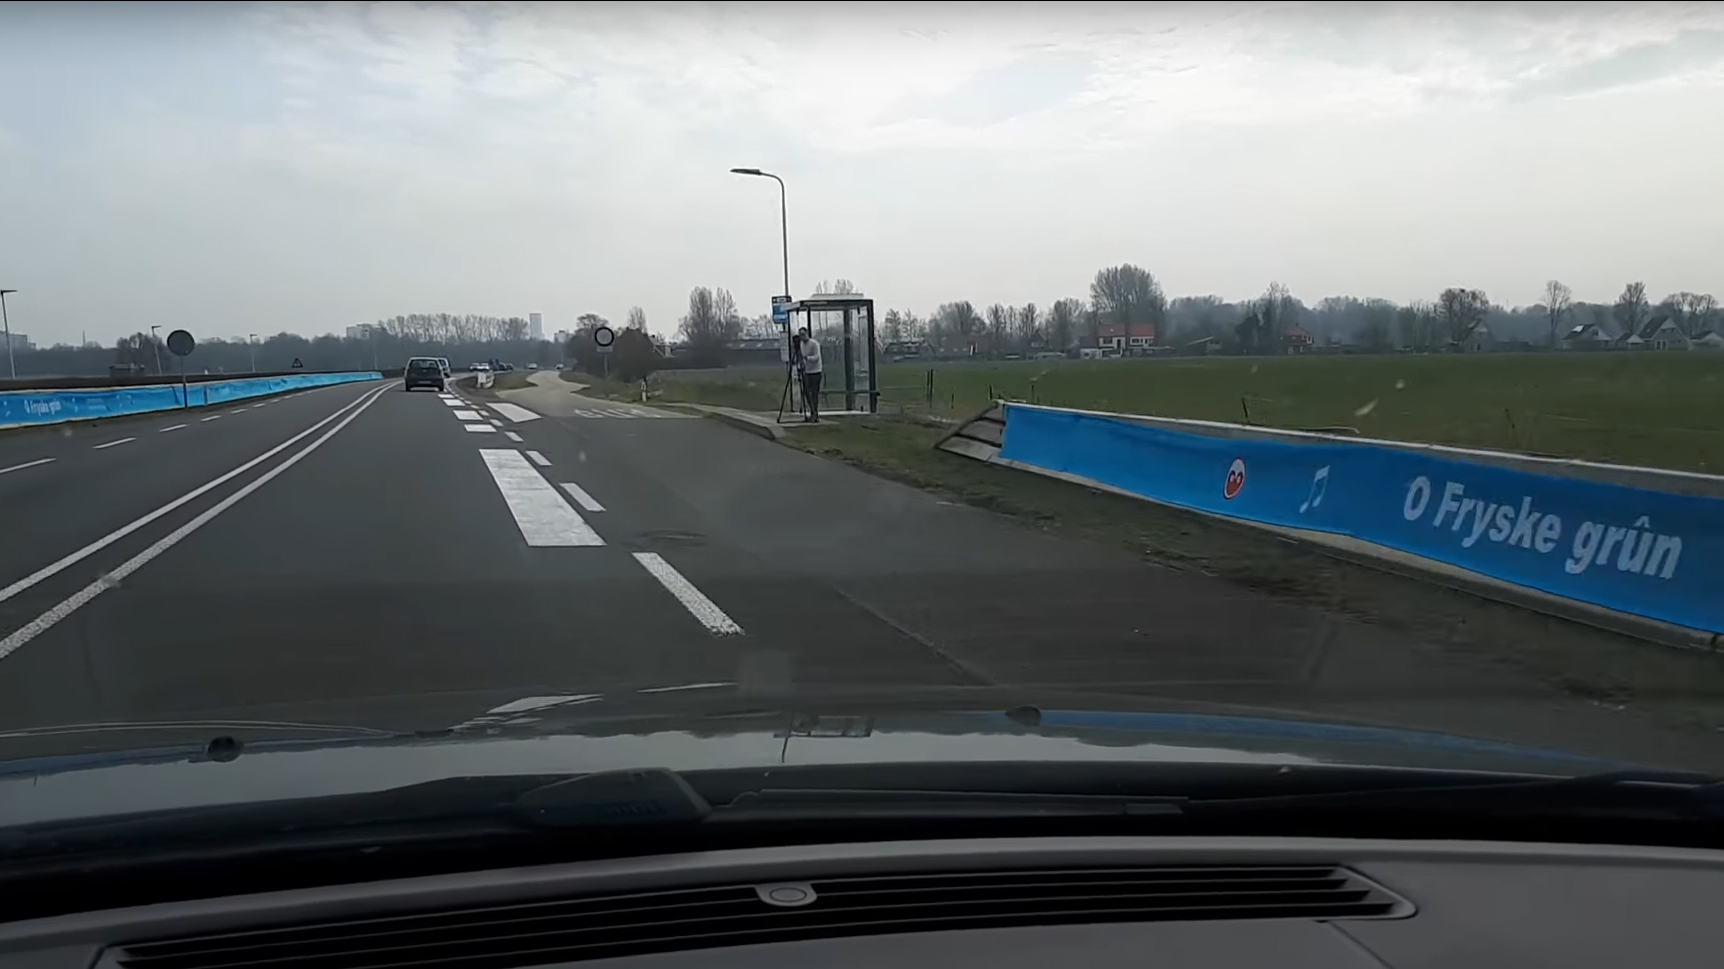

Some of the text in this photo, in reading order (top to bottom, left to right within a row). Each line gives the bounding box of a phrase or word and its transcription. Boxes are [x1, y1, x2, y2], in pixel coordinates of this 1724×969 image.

[1403, 475, 1683, 580] O Fryske grûn
